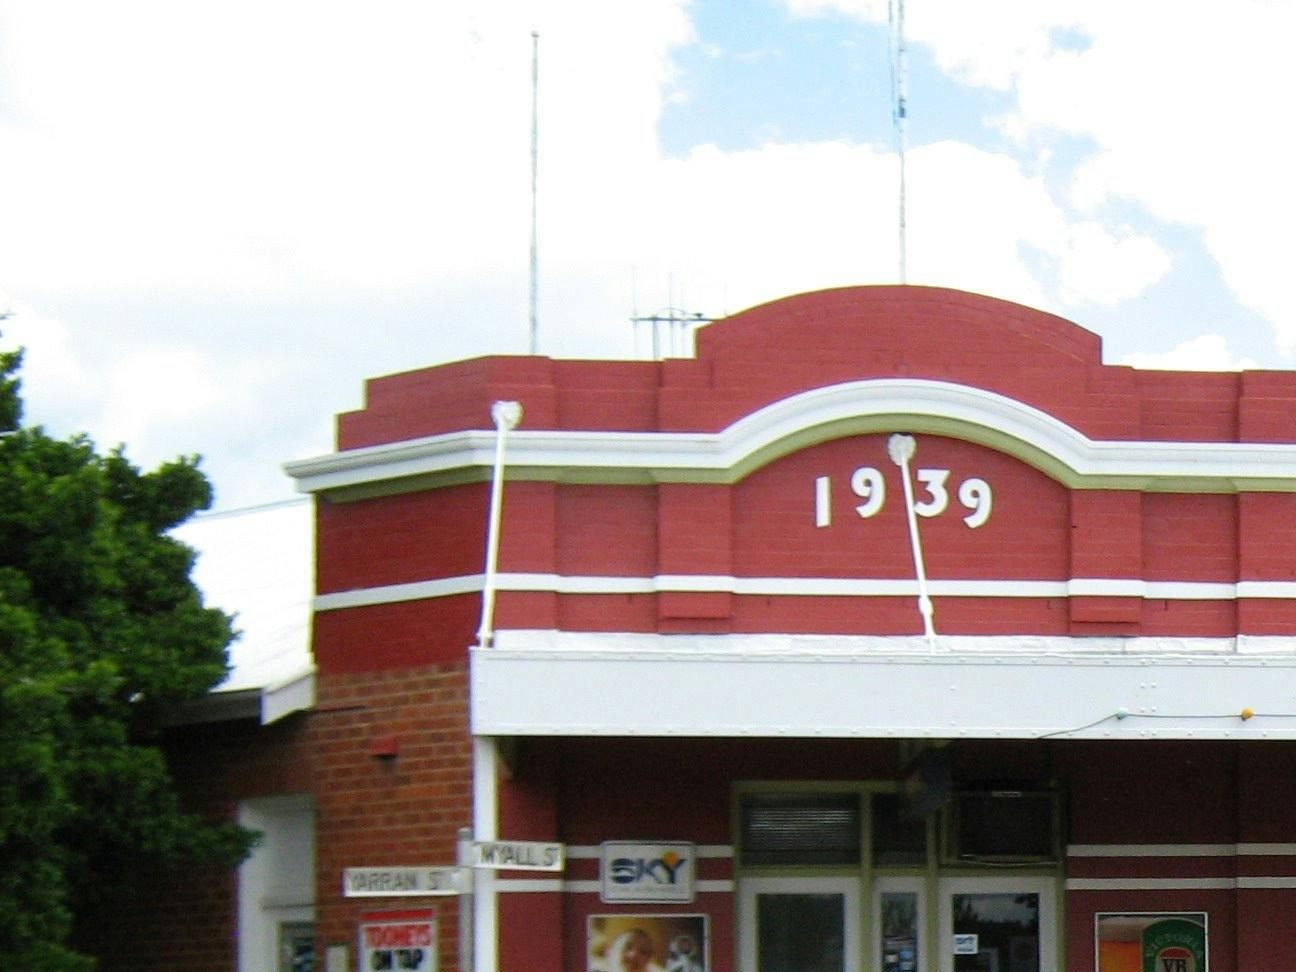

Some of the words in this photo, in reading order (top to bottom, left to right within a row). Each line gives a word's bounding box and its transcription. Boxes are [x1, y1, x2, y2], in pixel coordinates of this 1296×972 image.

[815, 467, 993, 529] 1939
[611, 857, 688, 885] SKY
[372, 950, 393, 972] ON
[396, 948, 424, 971] TAP
